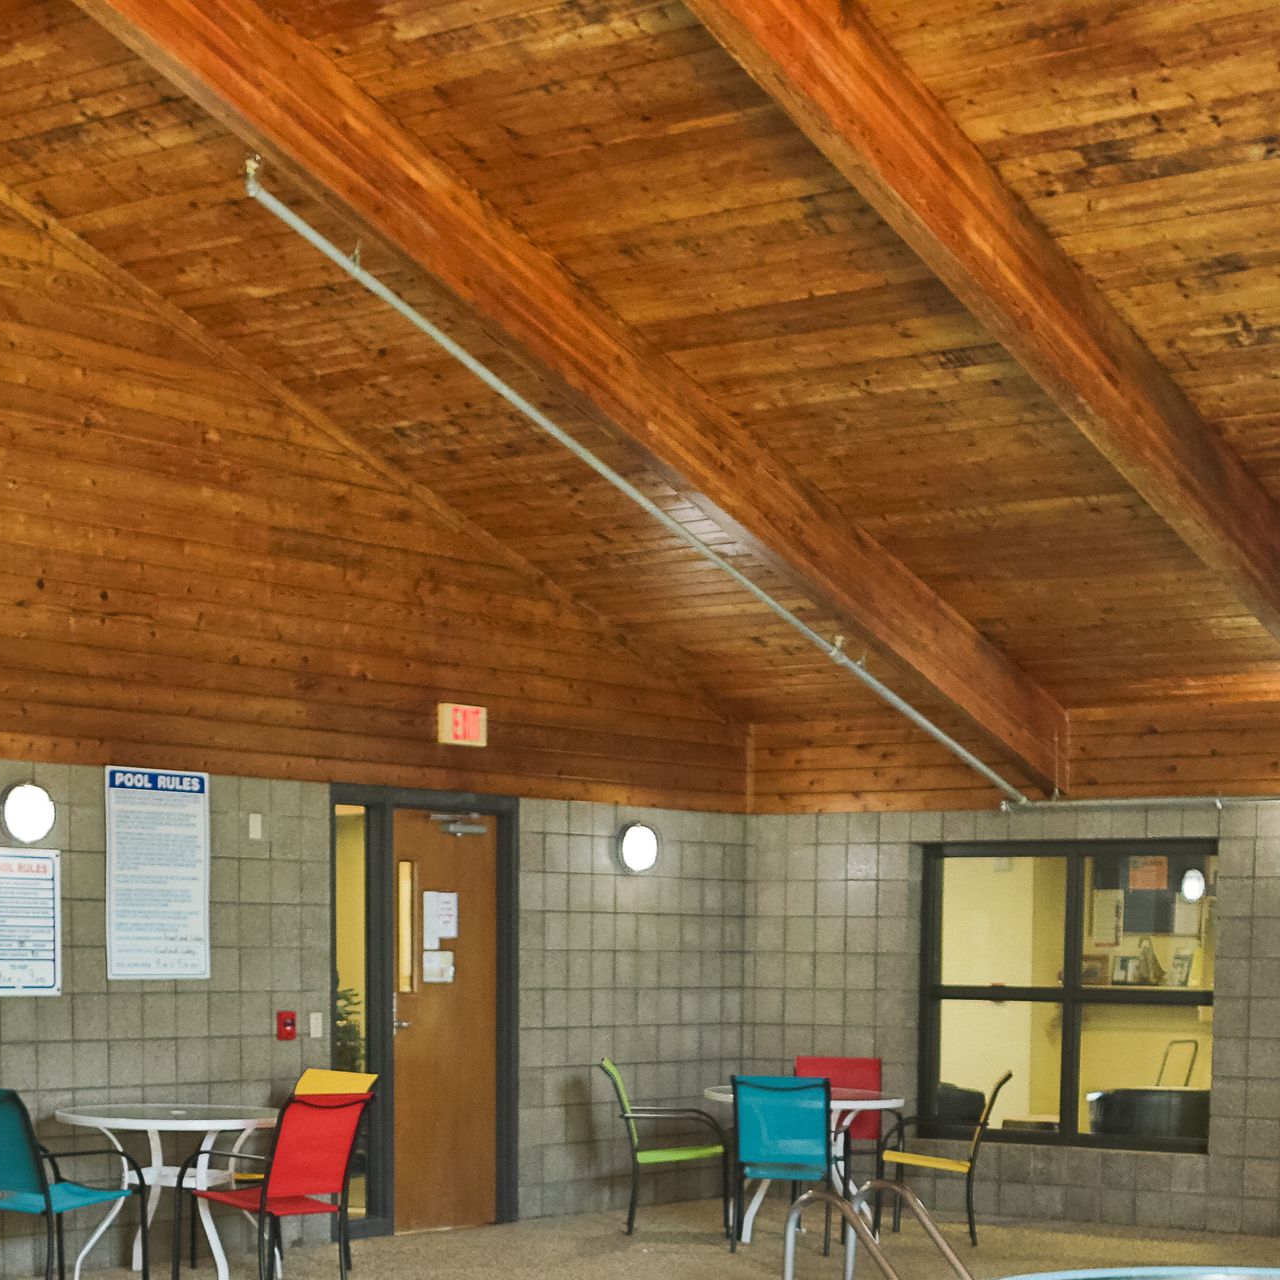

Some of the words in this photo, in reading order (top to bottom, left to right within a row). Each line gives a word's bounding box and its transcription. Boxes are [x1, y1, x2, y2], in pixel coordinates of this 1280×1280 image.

[115, 772, 152, 788] POOL
[157, 775, 200, 791] RULES
[17, 864, 48, 874] RULES
